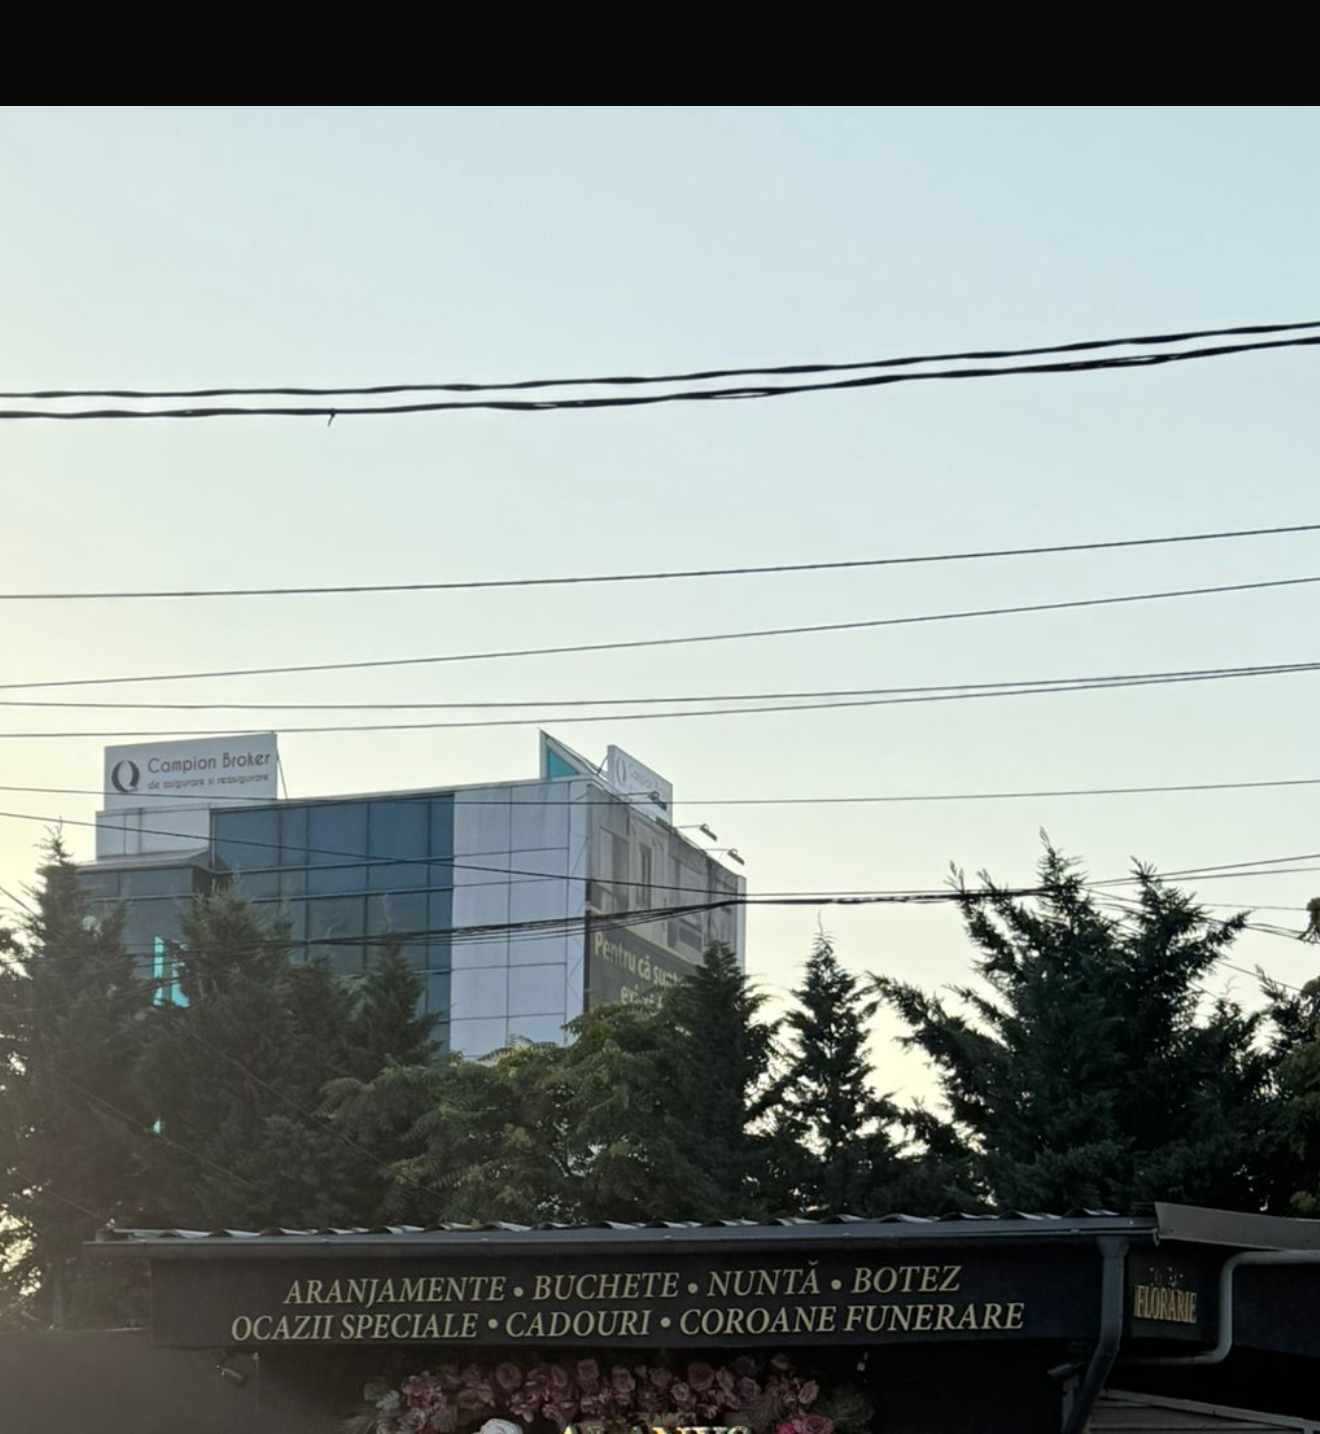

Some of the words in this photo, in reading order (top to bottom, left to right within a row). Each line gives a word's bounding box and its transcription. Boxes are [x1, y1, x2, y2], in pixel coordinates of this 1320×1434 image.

[147, 756, 216, 774] Campion
[223, 752, 270, 768] Broker
[148, 780, 160, 790] de
[594, 931, 636, 976] Pentru
[637, 954, 651, 980] că
[283, 1276, 507, 1307] ARANJAMENTE
[532, 1272, 680, 1300] BUCHETE
[706, 1260, 820, 1297] NUNTĂ
[851, 1265, 962, 1293] BOTEZ
[230, 1315, 333, 1341] OCAZII
[340, 1313, 478, 1339] SPECIALE
[505, 1310, 652, 1337] CADOURI
[679, 1306, 836, 1335] COROANE
[843, 1302, 1024, 1332] FUNERARE
[1135, 1285, 1197, 1323] FLORARIE
